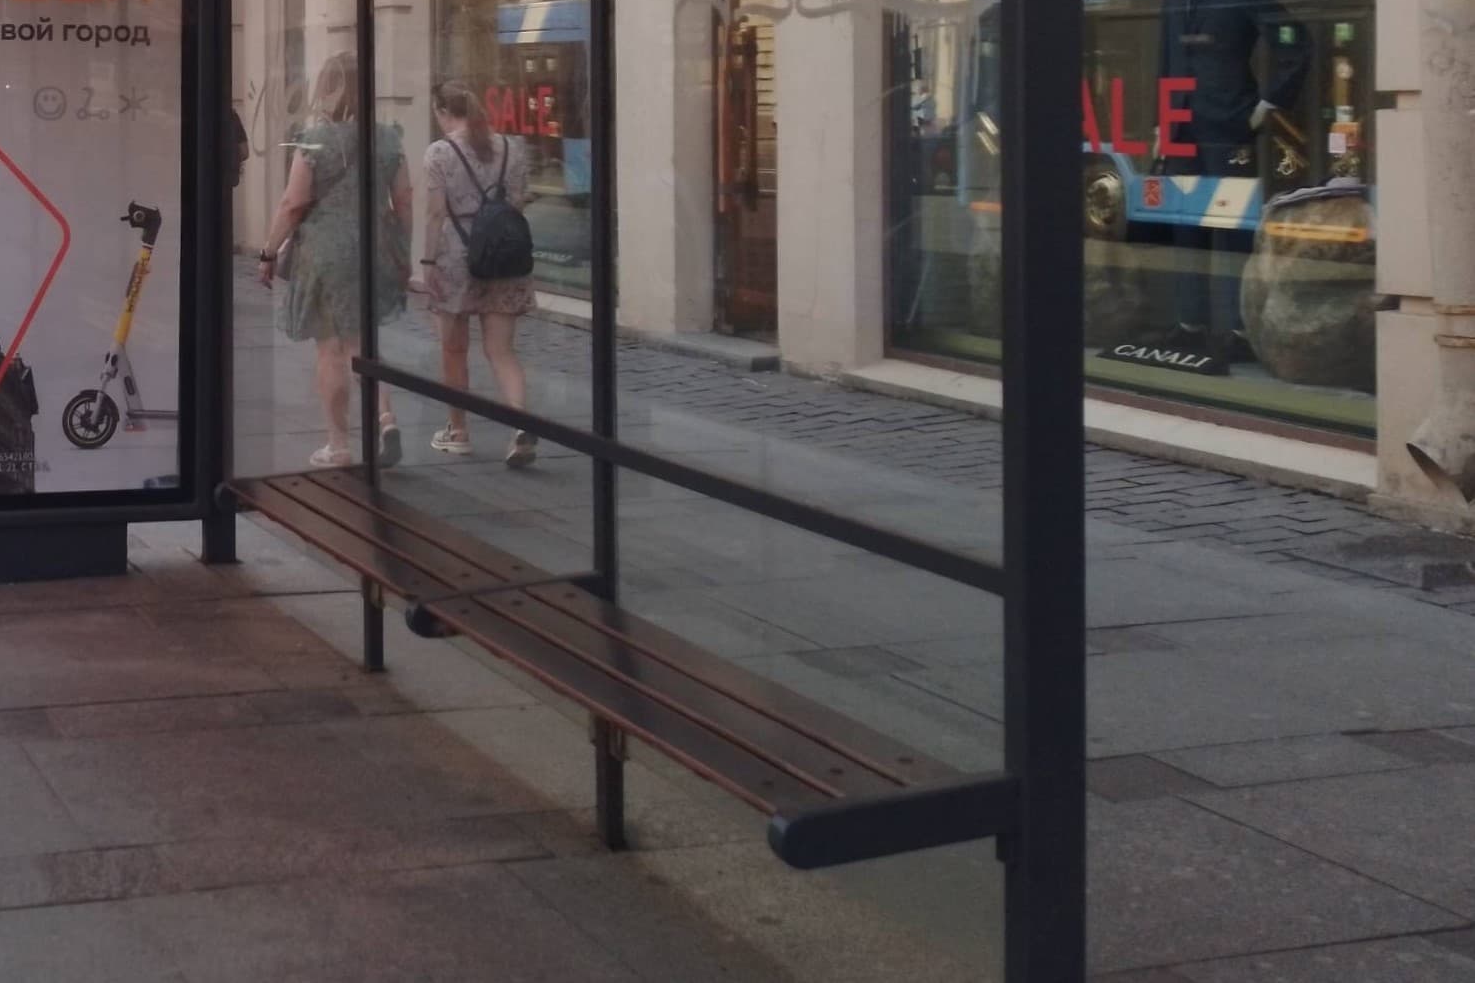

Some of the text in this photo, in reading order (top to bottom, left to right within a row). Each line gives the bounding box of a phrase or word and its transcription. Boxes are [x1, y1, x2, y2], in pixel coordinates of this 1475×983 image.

[62, 24, 151, 48] город
[486, 84, 553, 137] SALE
[1114, 343, 1213, 368] CANALI
